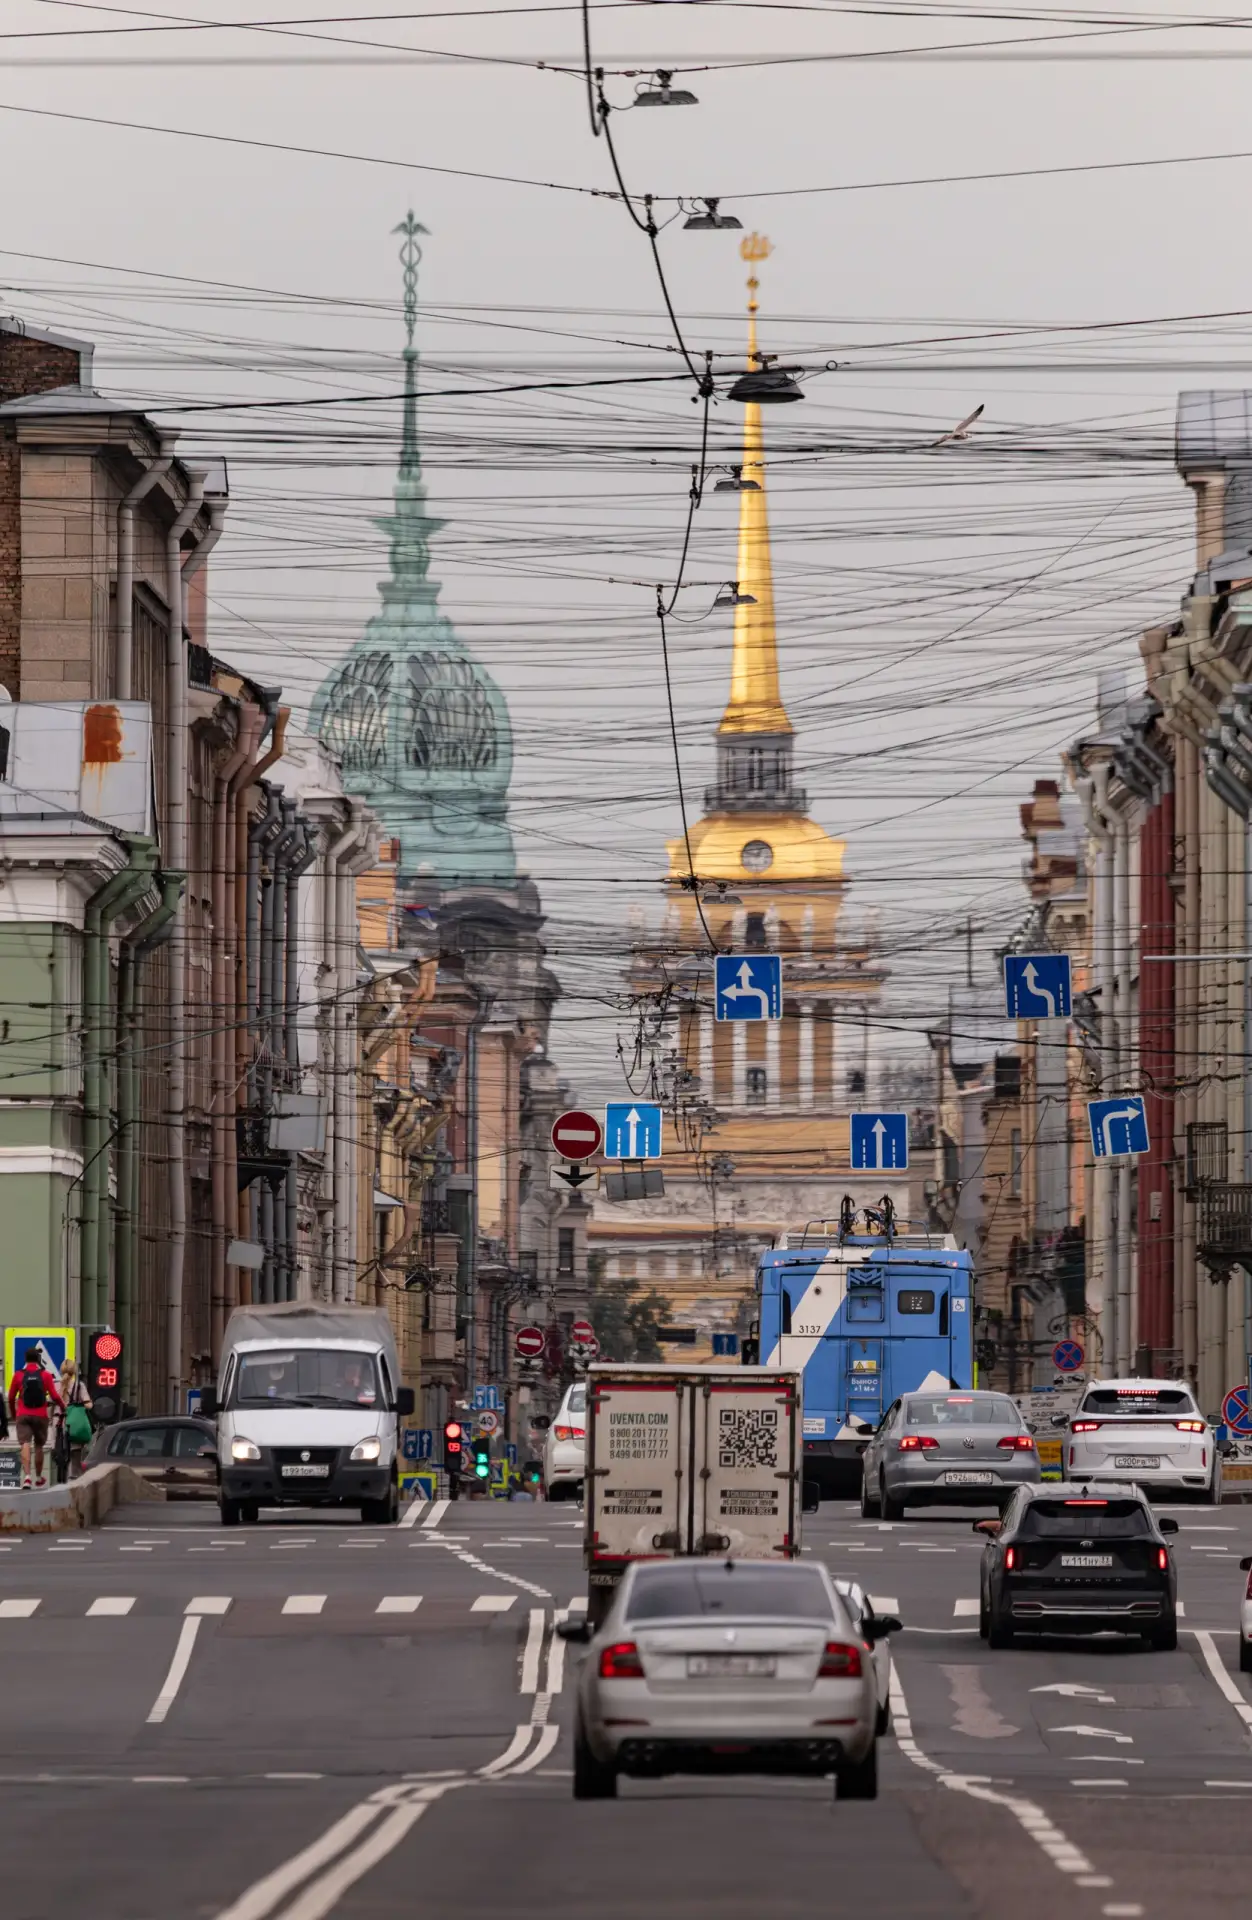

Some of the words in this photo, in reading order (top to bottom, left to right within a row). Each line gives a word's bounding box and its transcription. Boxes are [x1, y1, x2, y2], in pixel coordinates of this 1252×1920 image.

[799, 1325, 821, 1334] 3137
[98, 1367, 117, 1386] 28
[851, 1377, 878, 1385] Вынос
[479, 1415, 494, 1425] 40
[609, 1412, 669, 1425] UVENTA.COM
[609, 1428, 615, 1438] 8
[616, 1428, 631, 1438] 800
[631, 1428, 646, 1438] 201
[648, 1428, 658, 1438] 77
[658, 1428, 669, 1438] 77
[609, 1439, 615, 1448] 8
[616, 1439, 631, 1448] 812
[648, 1439, 658, 1448] 77
[658, 1439, 669, 1448] 77
[609, 1450, 615, 1459] 8
[615, 1450, 631, 1459] 499
[631, 1450, 646, 1459] 401
[648, 1450, 658, 1459] 77
[658, 1450, 669, 1459] 77
